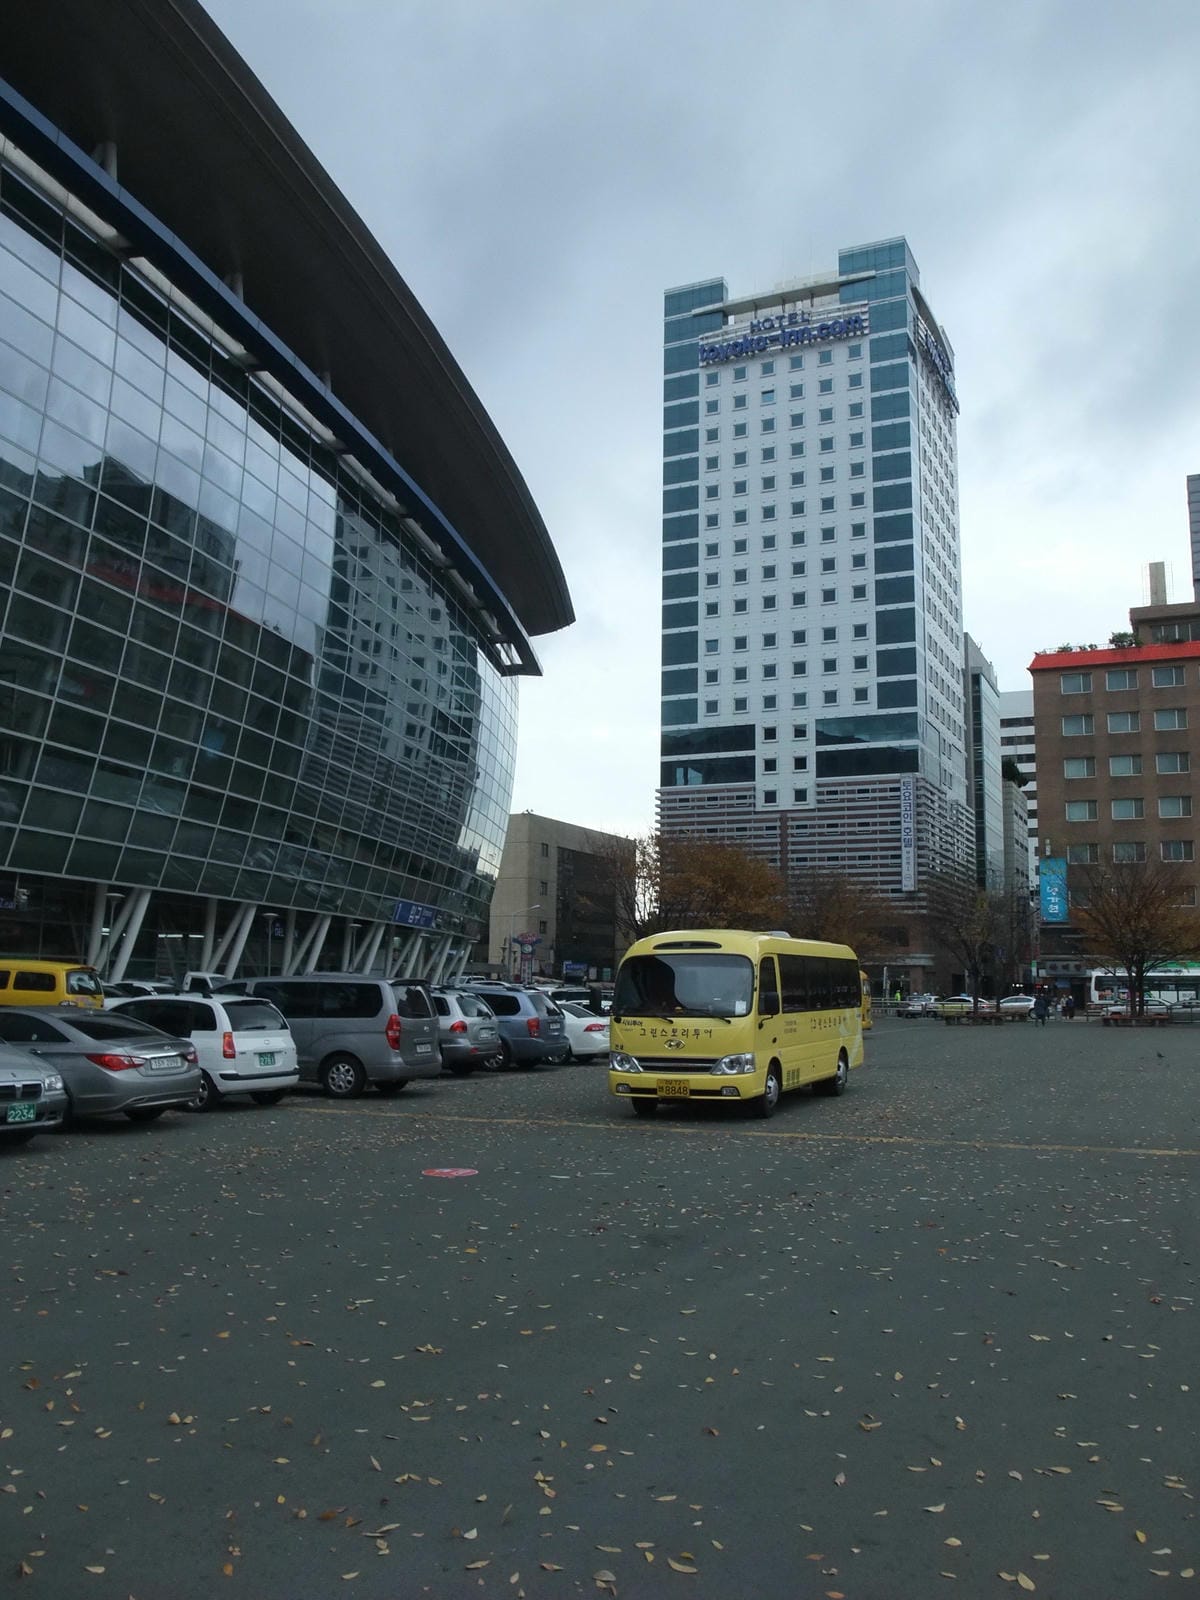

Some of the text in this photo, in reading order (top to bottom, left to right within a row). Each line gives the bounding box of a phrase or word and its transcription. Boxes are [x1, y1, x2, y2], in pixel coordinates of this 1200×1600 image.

[751, 311, 811, 332] HOTEL
[903, 781, 912, 823] 토요코인
[639, 1028, 713, 1039] 그린스토리투어
[665, 1085, 690, 1097] 8848
[8, 1109, 35, 1121] 2234
